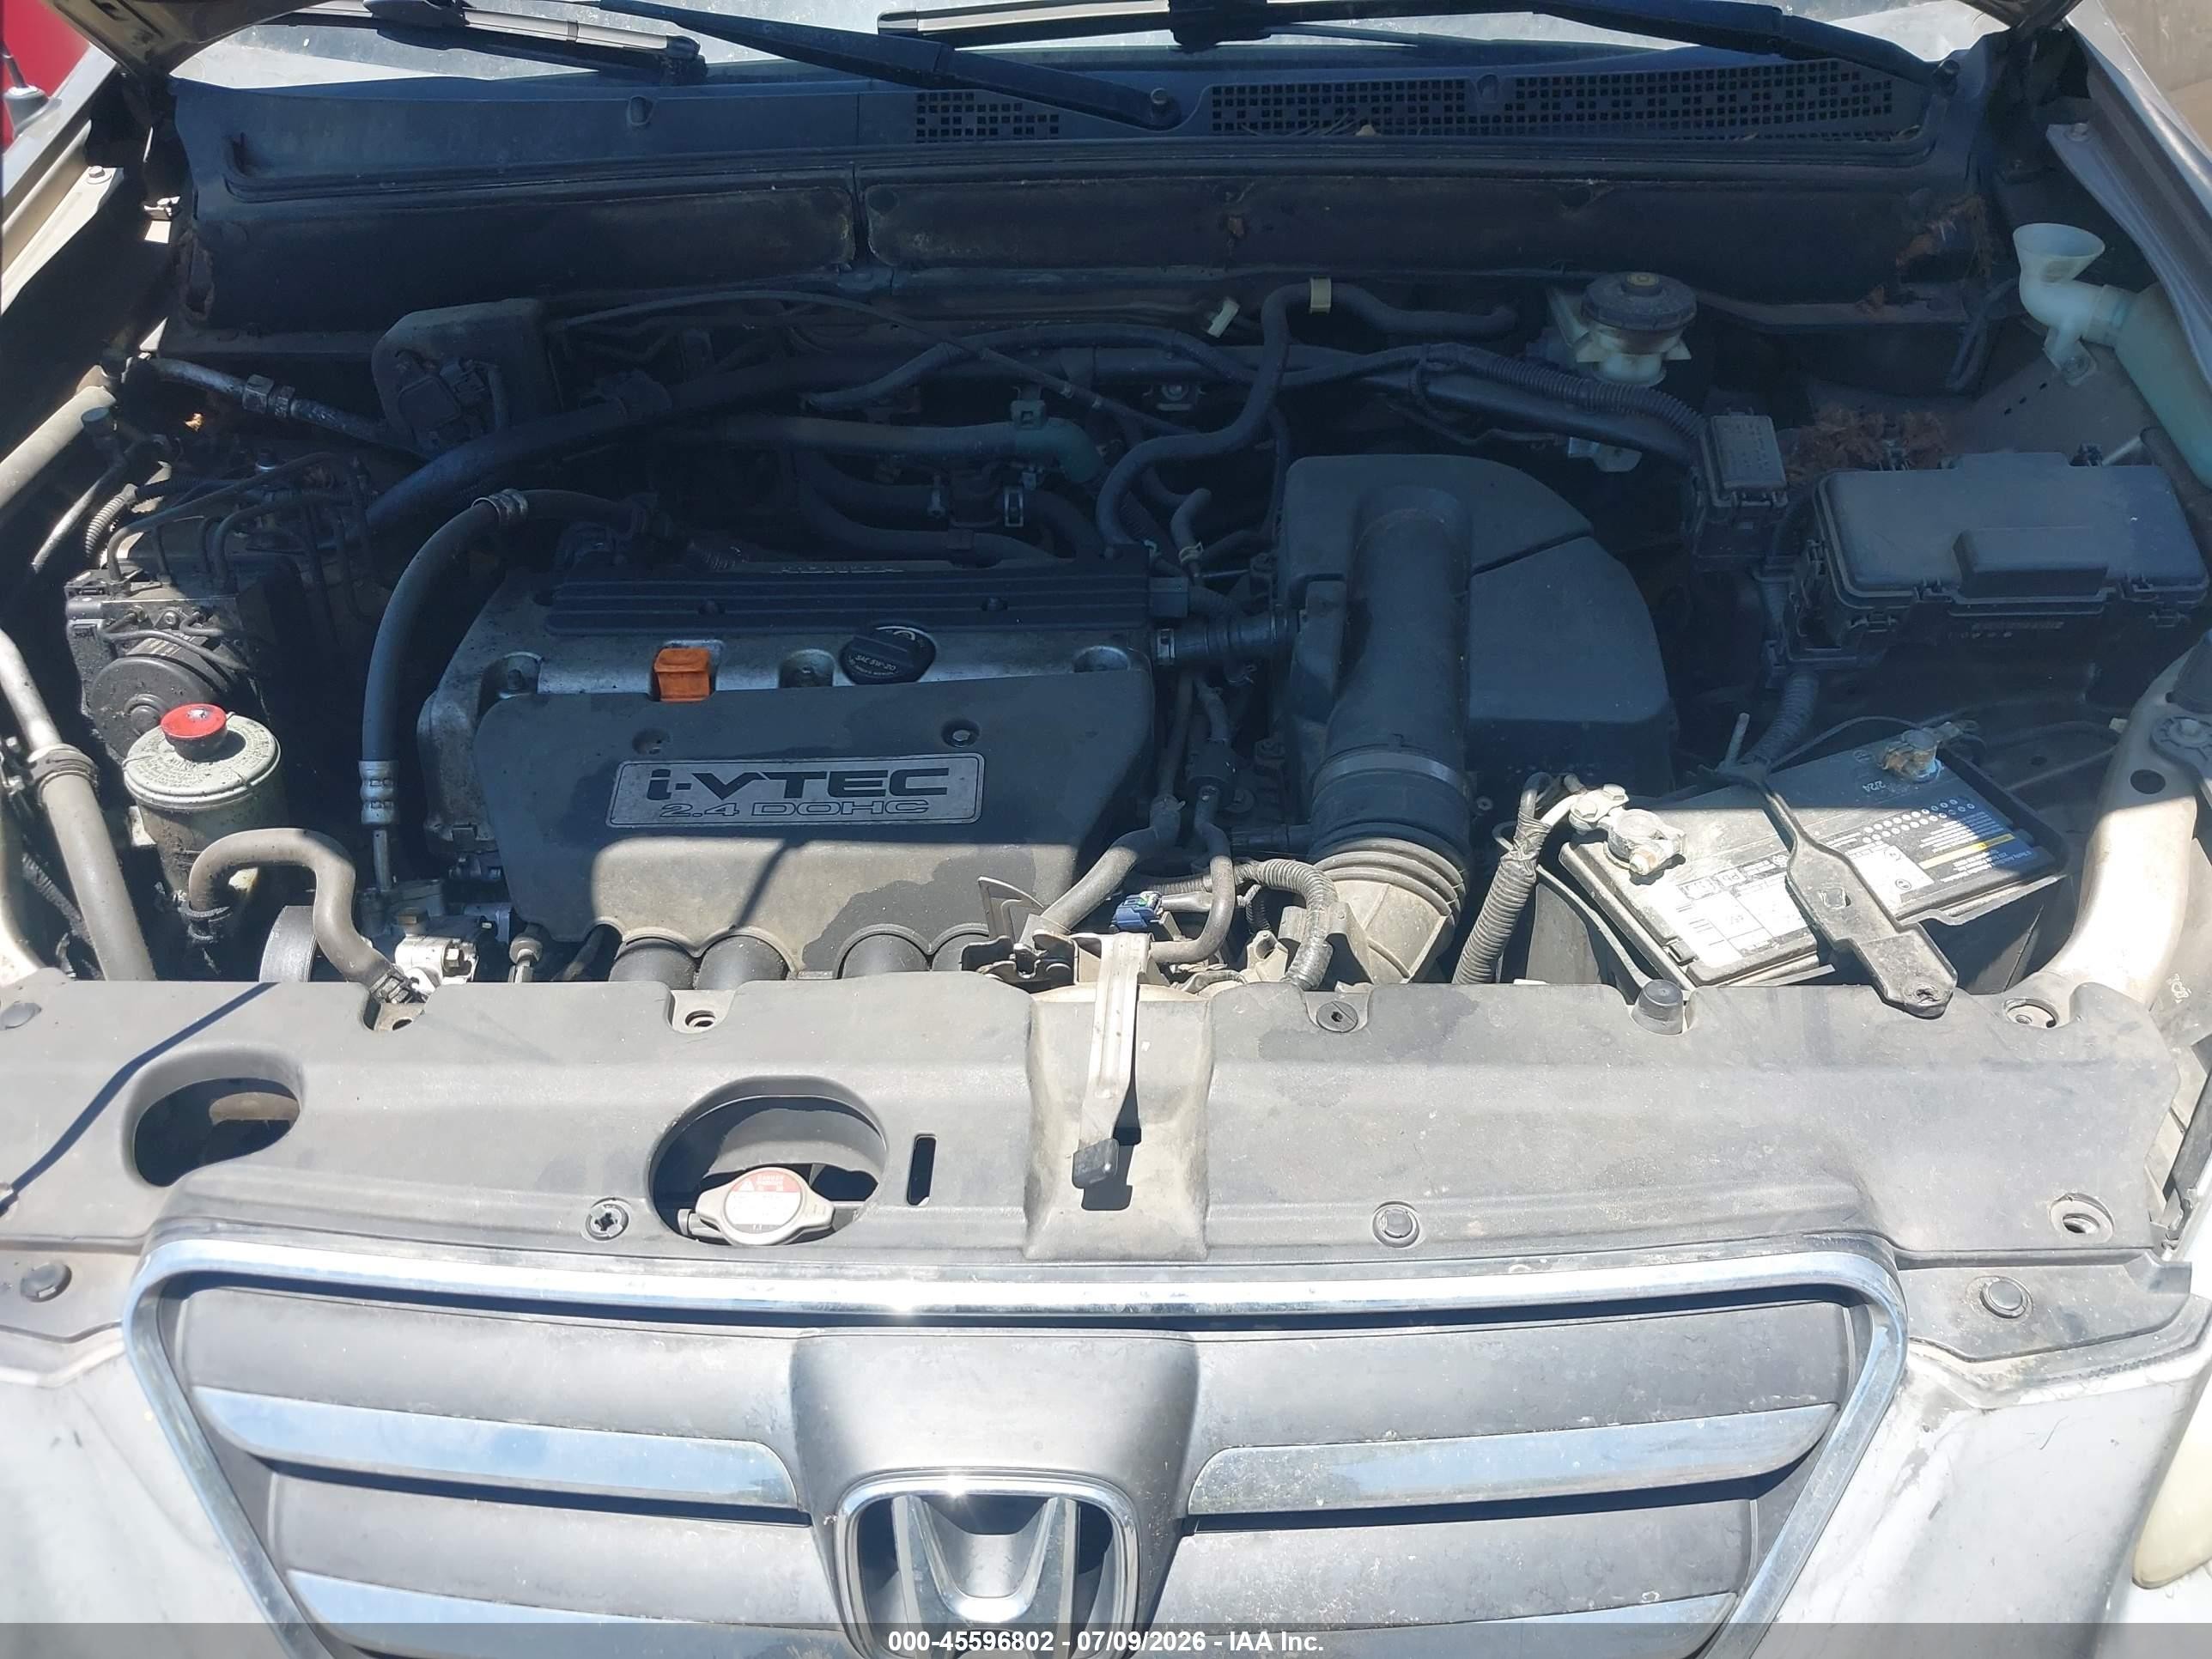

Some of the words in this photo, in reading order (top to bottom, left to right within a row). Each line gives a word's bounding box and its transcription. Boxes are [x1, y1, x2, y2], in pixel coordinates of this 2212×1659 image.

[647, 768, 949, 801] i-VTEC
[659, 803, 739, 817] 2.4
[751, 799, 929, 816] DOHC
